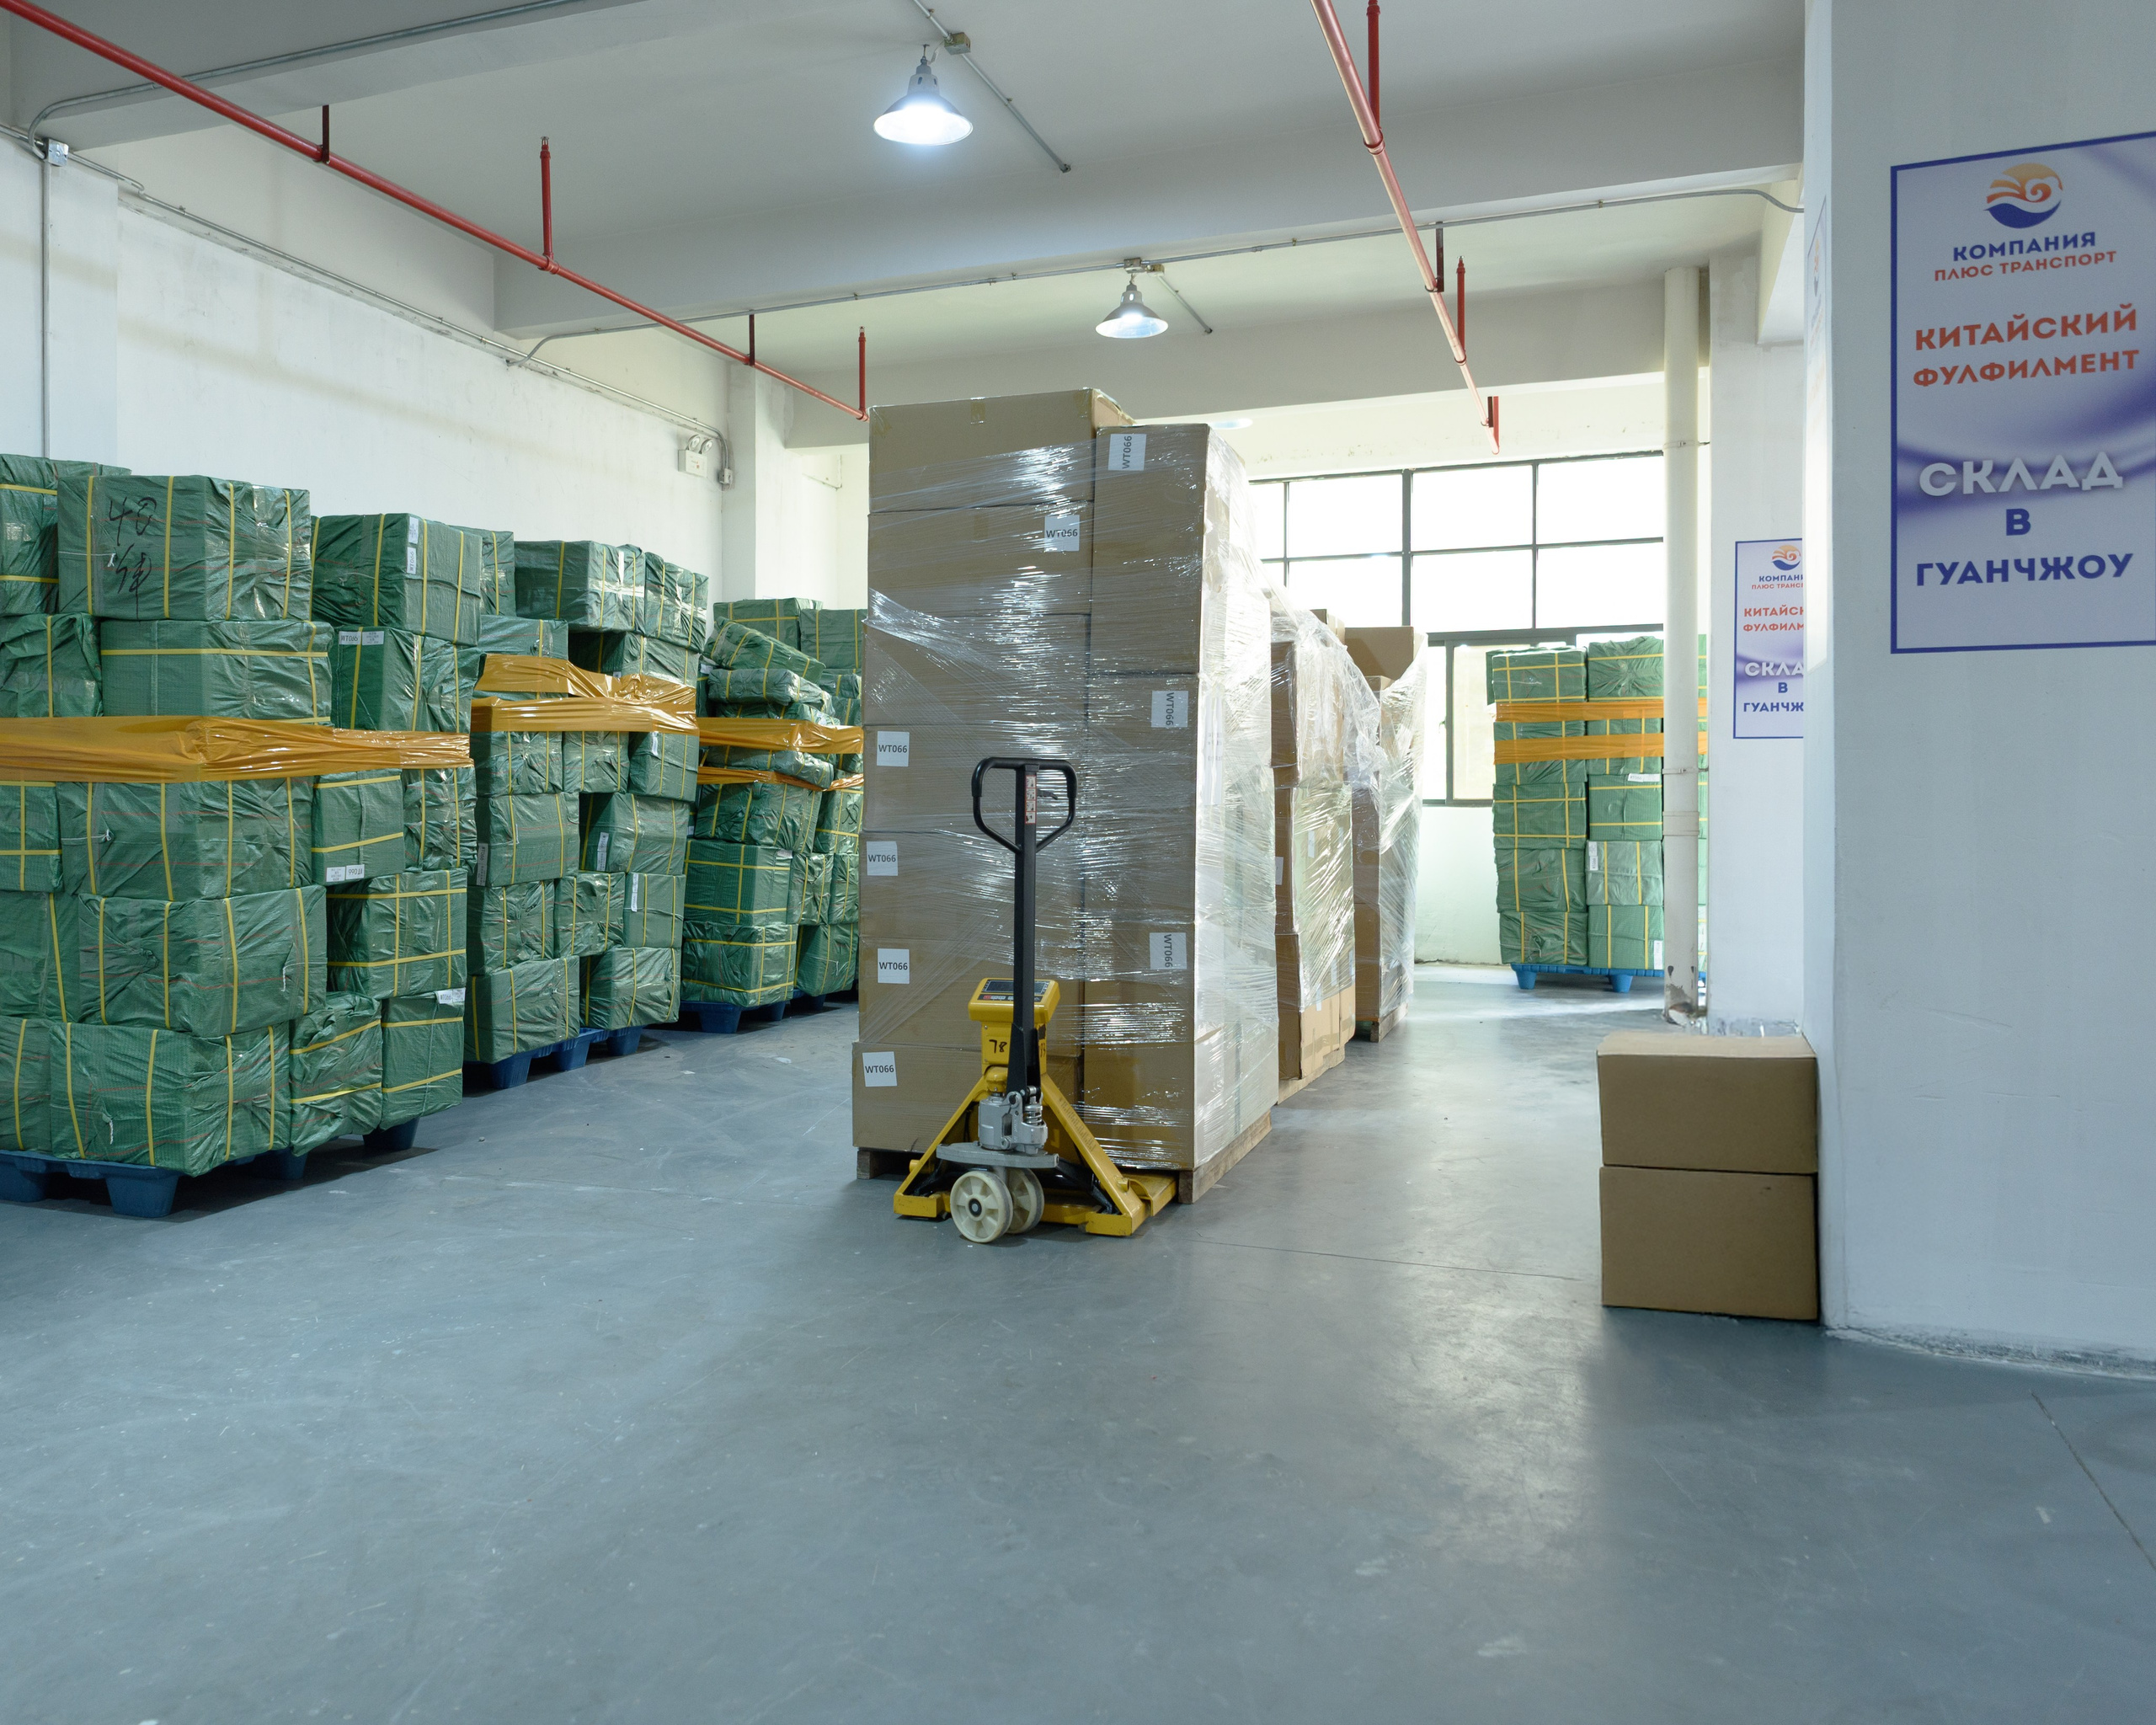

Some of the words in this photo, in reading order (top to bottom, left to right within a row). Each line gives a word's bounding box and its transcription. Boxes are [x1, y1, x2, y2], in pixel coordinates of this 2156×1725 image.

[1953, 232, 2095, 261] КОМПАНИЯ
[1935, 264, 1993, 281] ПЛЮС
[1999, 251, 2117, 274] ТРАНСПОРТ
[1915, 303, 2137, 350] КИТАЙСКИЙ
[1913, 350, 2139, 387] ФУЛФИЛМЕНТ
[1122, 435, 1133, 469] WT066
[1919, 451, 2123, 496] СКЛАД
[1046, 529, 1078, 538] WT066
[2006, 508, 2031, 536] В
[1916, 553, 2133, 586] ГУАНЧЖОУ
[1778, 682, 1788, 693] В
[1166, 692, 1175, 726] WT066
[1743, 702, 1804, 712] ГУАНЧЖ
[878, 745, 908, 754] WT066
[1164, 934, 1173, 968] WT066
[879, 962, 908, 970] WT066
[989, 1039, 1007, 1054] 78
[865, 1065, 894, 1073] WT066
